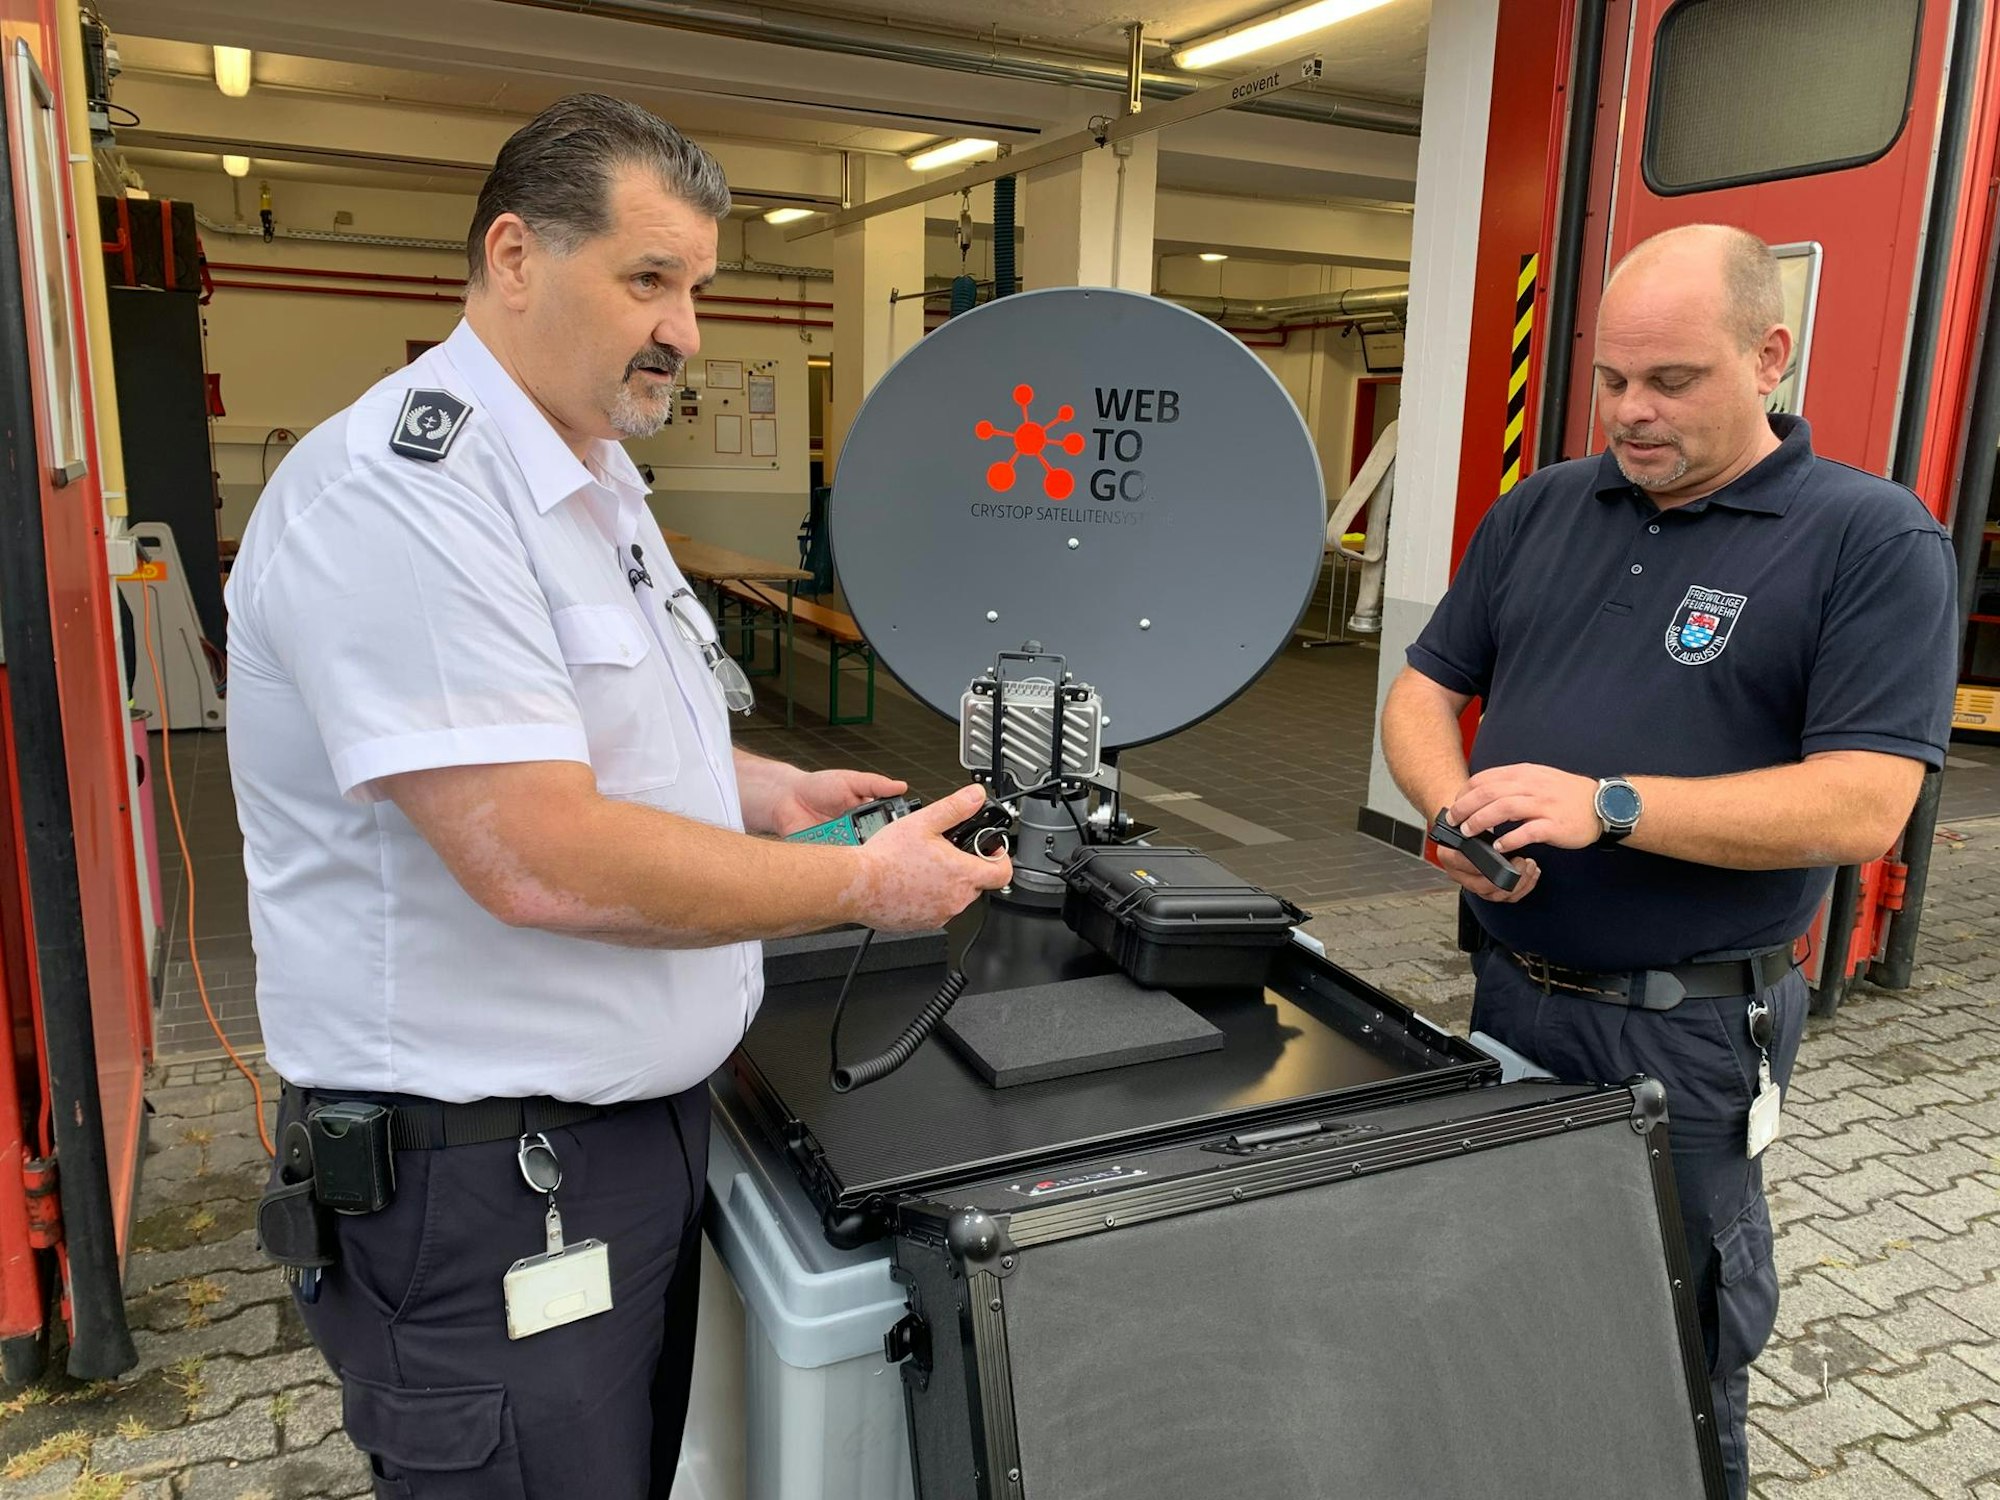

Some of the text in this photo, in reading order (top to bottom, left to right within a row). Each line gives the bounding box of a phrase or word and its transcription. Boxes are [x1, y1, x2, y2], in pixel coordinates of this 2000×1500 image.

[1232, 71, 1280, 99] ecovent
[1094, 387, 1180, 424] WEB
[1092, 428, 1143, 463] TO
[1090, 468, 1147, 503] GO
[970, 502, 1033, 521] CRYSTOP
[1684, 599, 1737, 618] FEUERWEHR
[1689, 589, 1741, 608] FREIWILLIGE
[1668, 625, 1725, 662] SANKT AUGUSTIN
